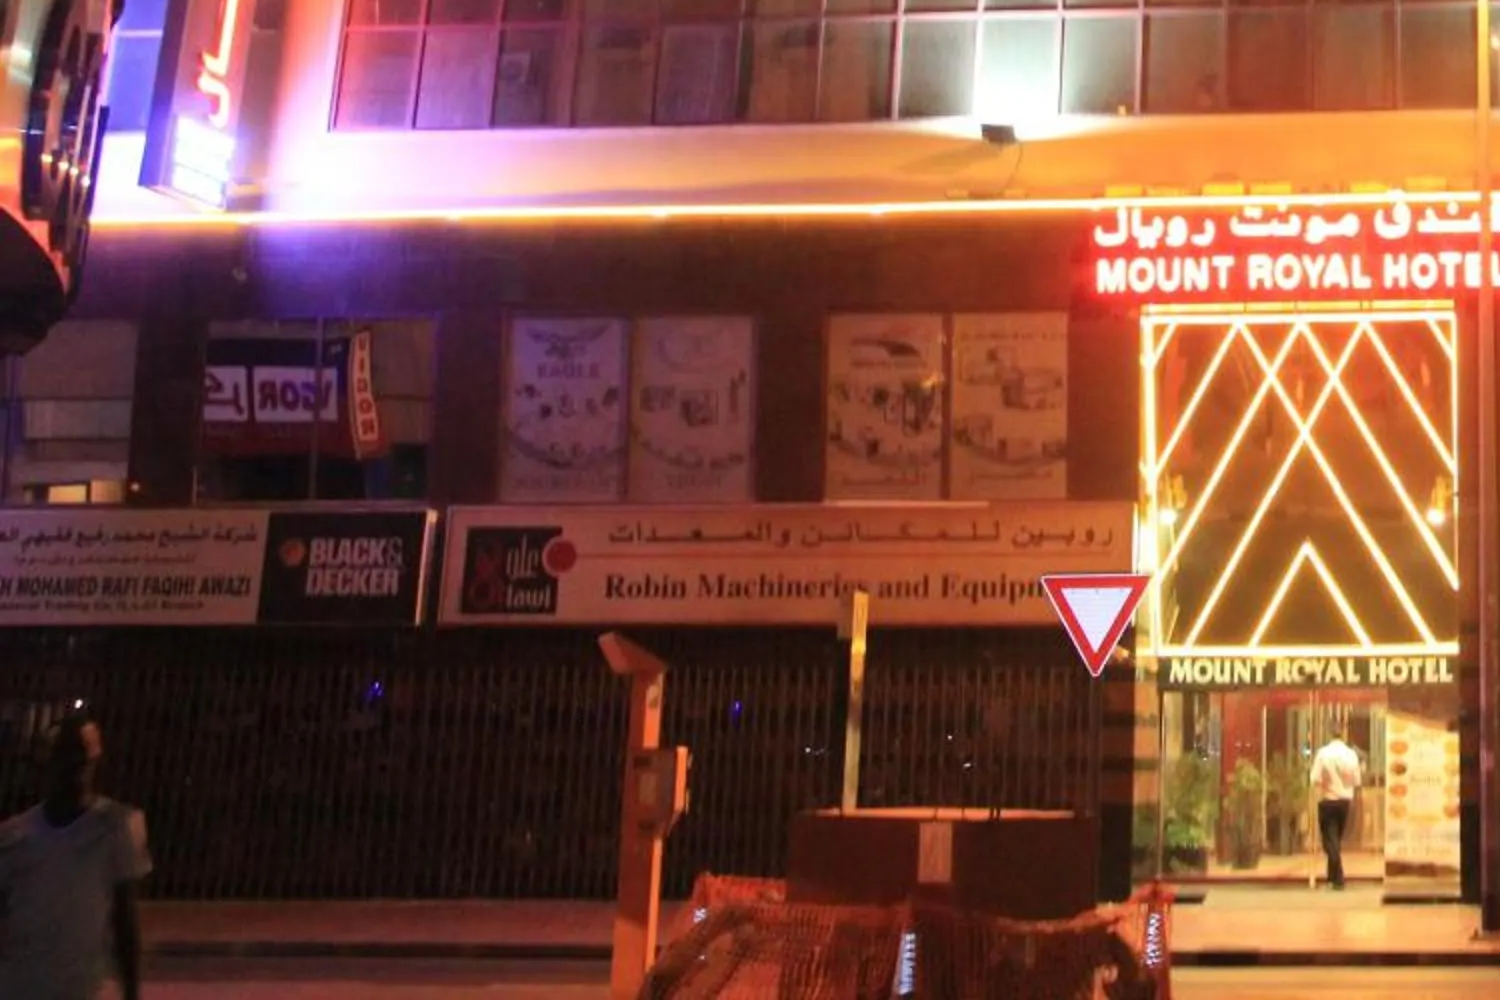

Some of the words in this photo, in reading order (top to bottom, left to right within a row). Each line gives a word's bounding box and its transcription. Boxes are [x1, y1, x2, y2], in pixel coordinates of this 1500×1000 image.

[1094, 204, 1216, 249] رويال
[1096, 255, 1235, 294] MOUNT
[1247, 253, 1372, 290] ROYAL
[18, 576, 97, 596] MOHAMED
[101, 576, 139, 596] RAFI
[305, 566, 398, 597] DECKER
[604, 574, 687, 600] Robin
[698, 574, 870, 599] Machineries
[878, 575, 930, 599] and
[1169, 658, 1266, 683] MOUNT
[1275, 658, 1360, 683] ROYAL
[1369, 657, 1453, 683] HOTEL
